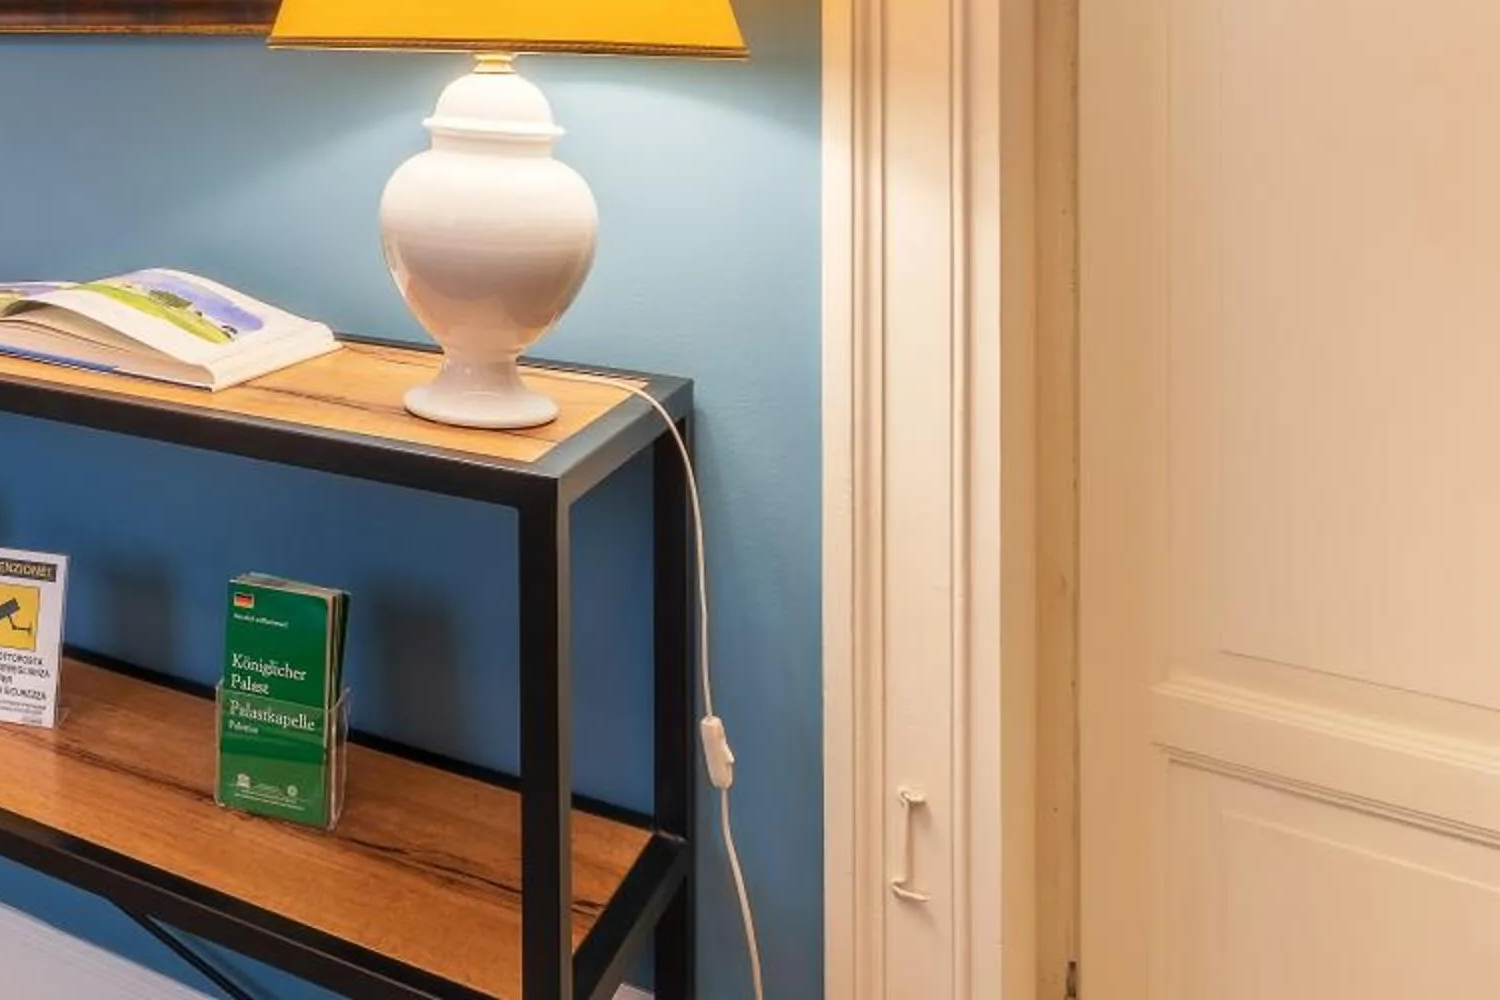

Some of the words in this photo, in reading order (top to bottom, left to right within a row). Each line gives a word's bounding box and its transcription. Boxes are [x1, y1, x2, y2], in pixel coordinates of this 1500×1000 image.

[231, 652, 307, 681] Königlicher
[3, 686, 47, 701] SICUREZZA
[231, 673, 269, 695] Palast
[229, 699, 315, 732] Palastkapelle
